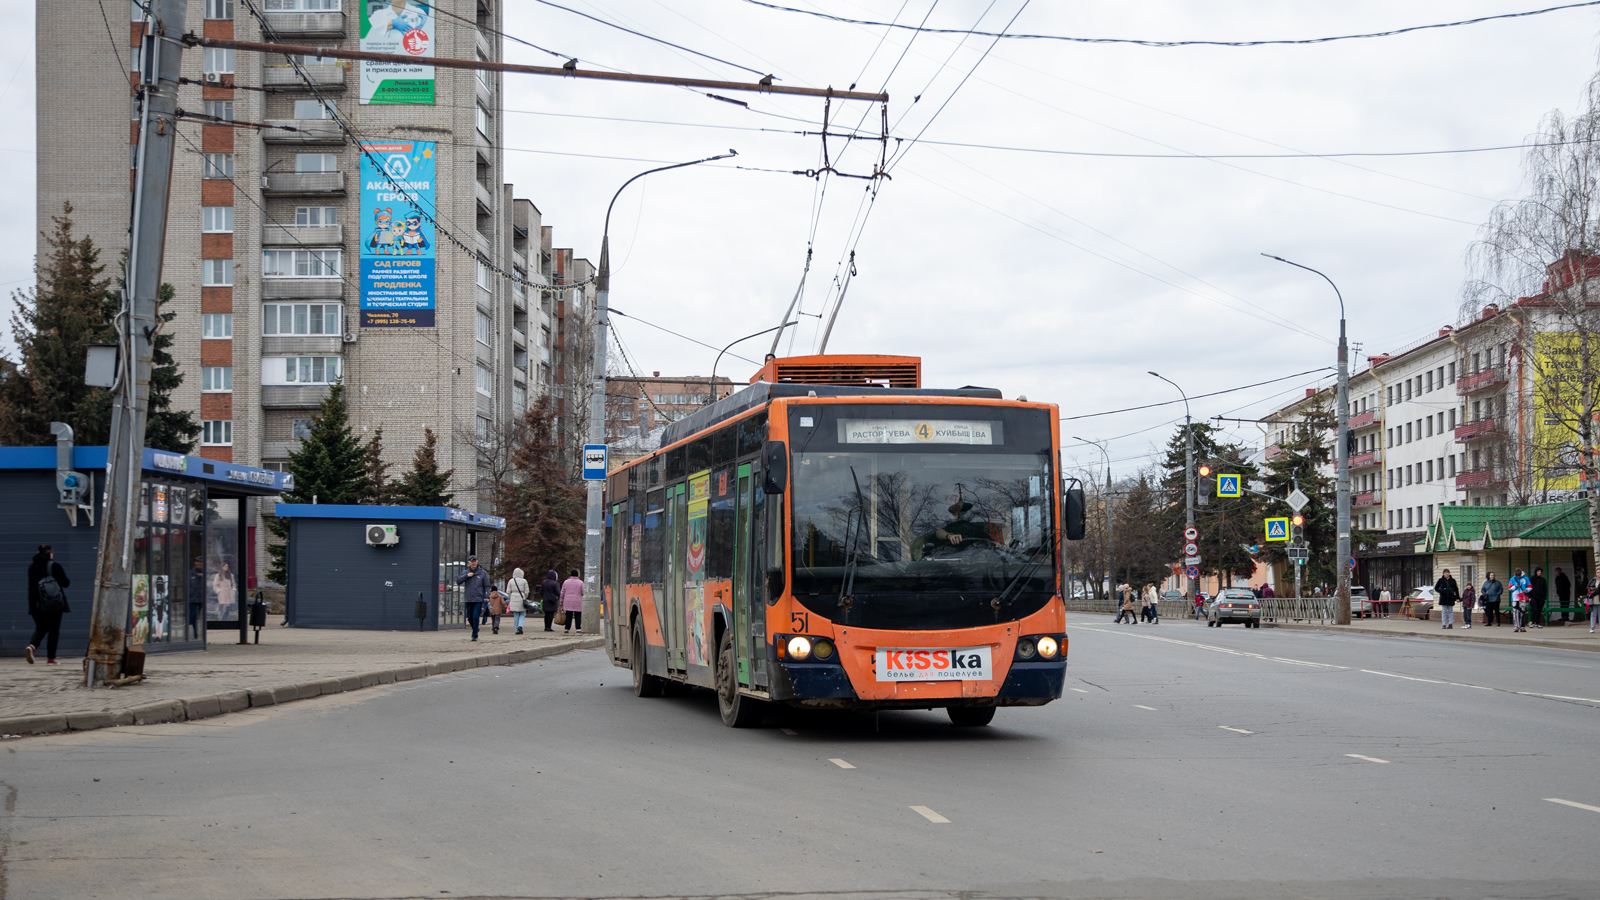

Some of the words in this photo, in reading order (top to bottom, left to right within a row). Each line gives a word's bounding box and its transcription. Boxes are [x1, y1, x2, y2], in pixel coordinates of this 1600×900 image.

[918, 424, 929, 438] 4
[936, 429, 986, 438] КУЙБЫШЕВА
[792, 612, 808, 633] 51
